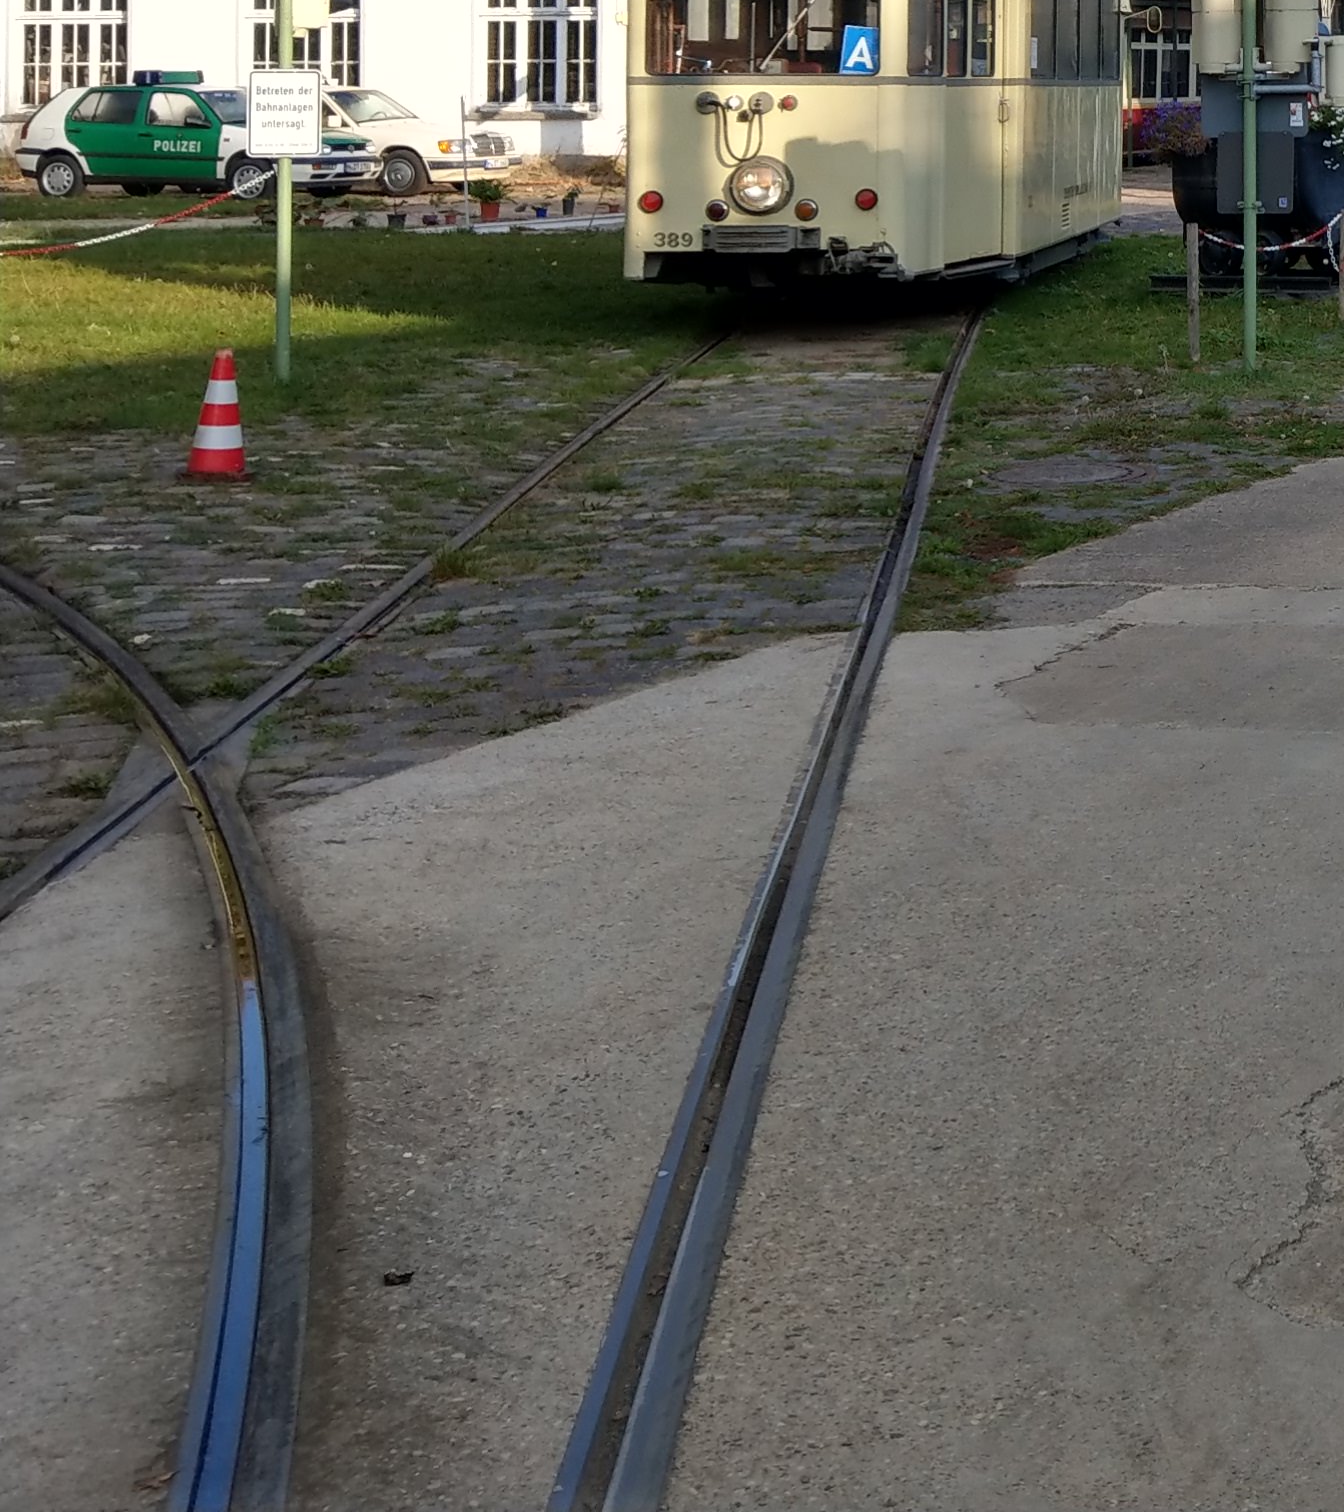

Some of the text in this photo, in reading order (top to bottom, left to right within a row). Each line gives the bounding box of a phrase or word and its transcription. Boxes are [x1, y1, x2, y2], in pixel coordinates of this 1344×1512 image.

[845, 36, 874, 70] A
[256, 85, 313, 95] Betreten der
[255, 102, 313, 114] Bahnanlagen
[153, 139, 202, 153] POLIZEI
[653, 232, 693, 248] 389
